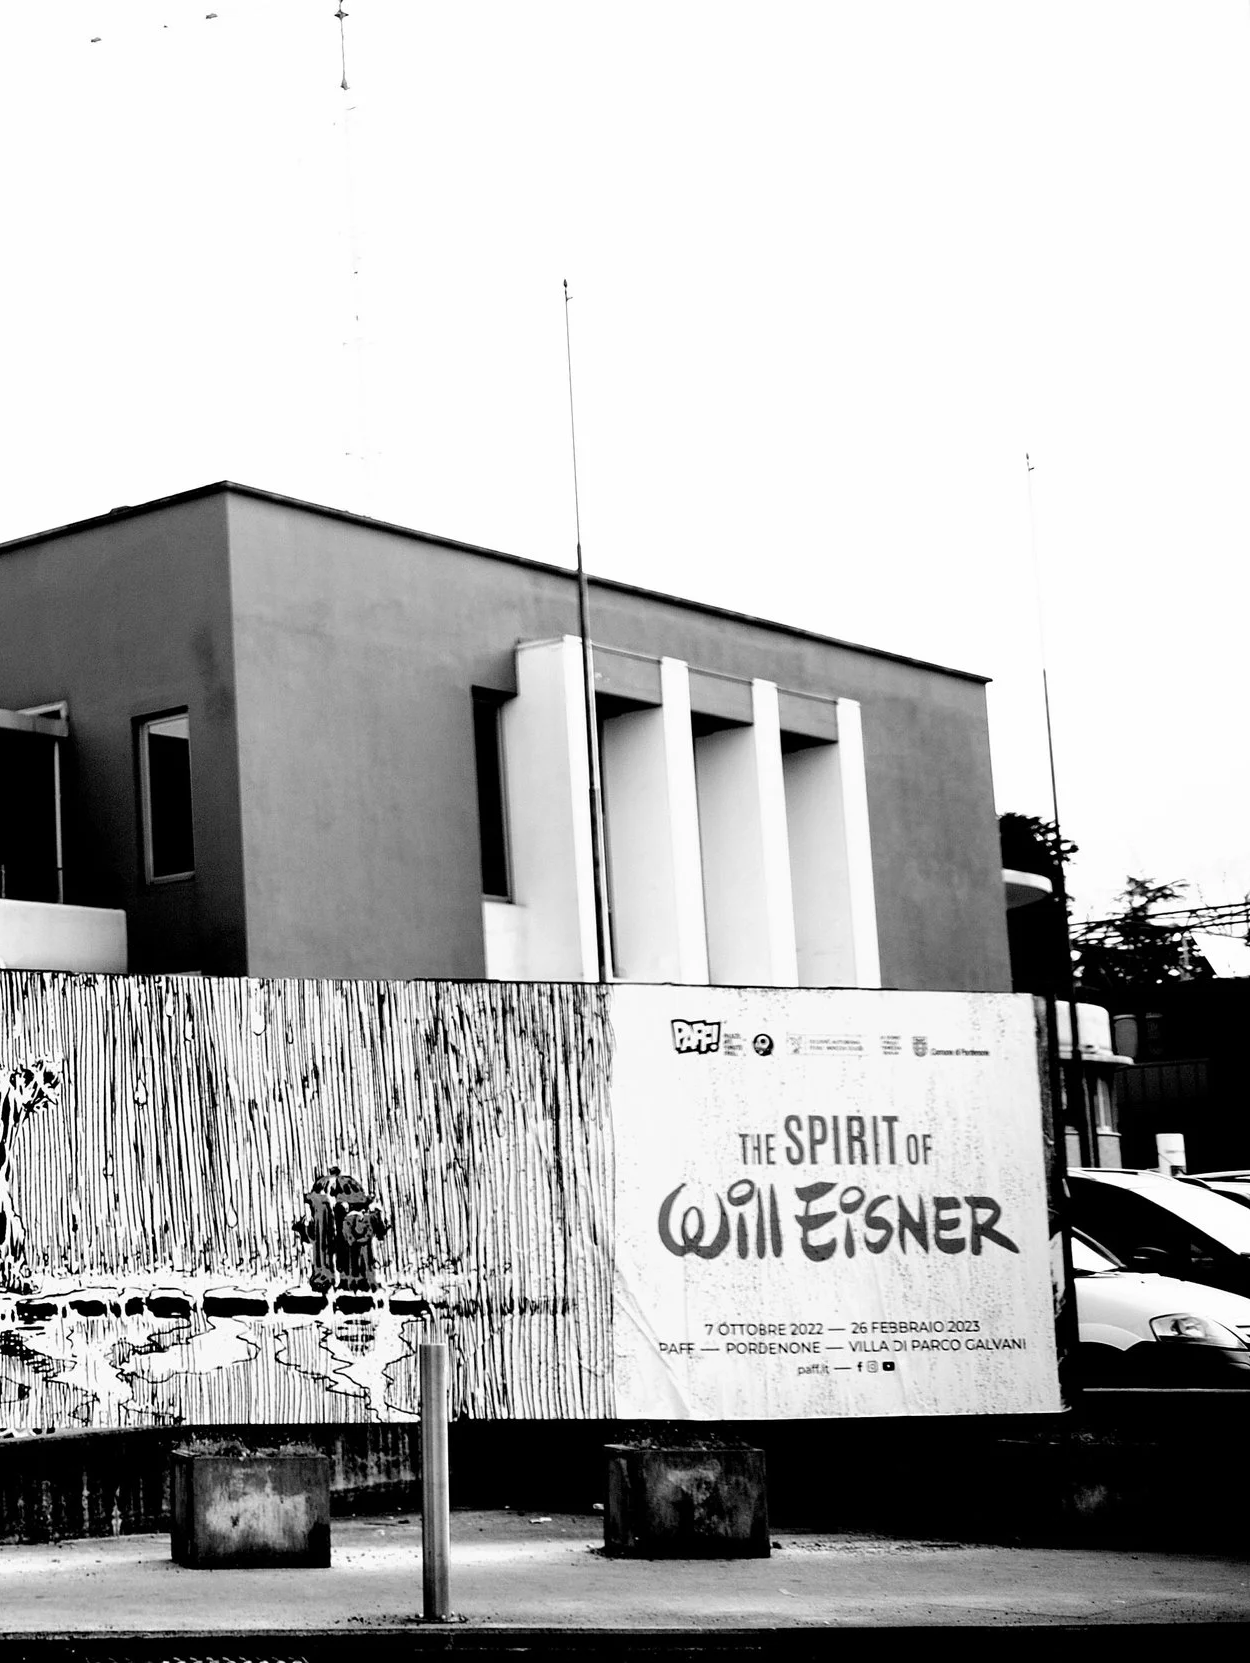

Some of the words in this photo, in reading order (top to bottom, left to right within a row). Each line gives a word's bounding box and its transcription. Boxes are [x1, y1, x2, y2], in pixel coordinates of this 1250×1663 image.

[739, 1133, 776, 1165] THE
[784, 1114, 899, 1165] SPIRIT
[906, 1134, 932, 1165] OF
[704, 1323, 714, 1336] 7
[718, 1322, 786, 1336] OTTOBRE
[790, 1323, 824, 1335] 2022
[851, 1321, 868, 1334] 26
[871, 1320, 944, 1334] FEBBRAIO
[947, 1320, 981, 1332] 2023
[658, 1342, 695, 1355] PAFF
[726, 1341, 821, 1355] PORDENONE
[848, 1340, 890, 1352] VILLA
[894, 1340, 907, 1351] DI
[911, 1339, 962, 1351] PARCO
[965, 1338, 1027, 1350] GALVANI
[797, 1362, 830, 1375] paff.it
